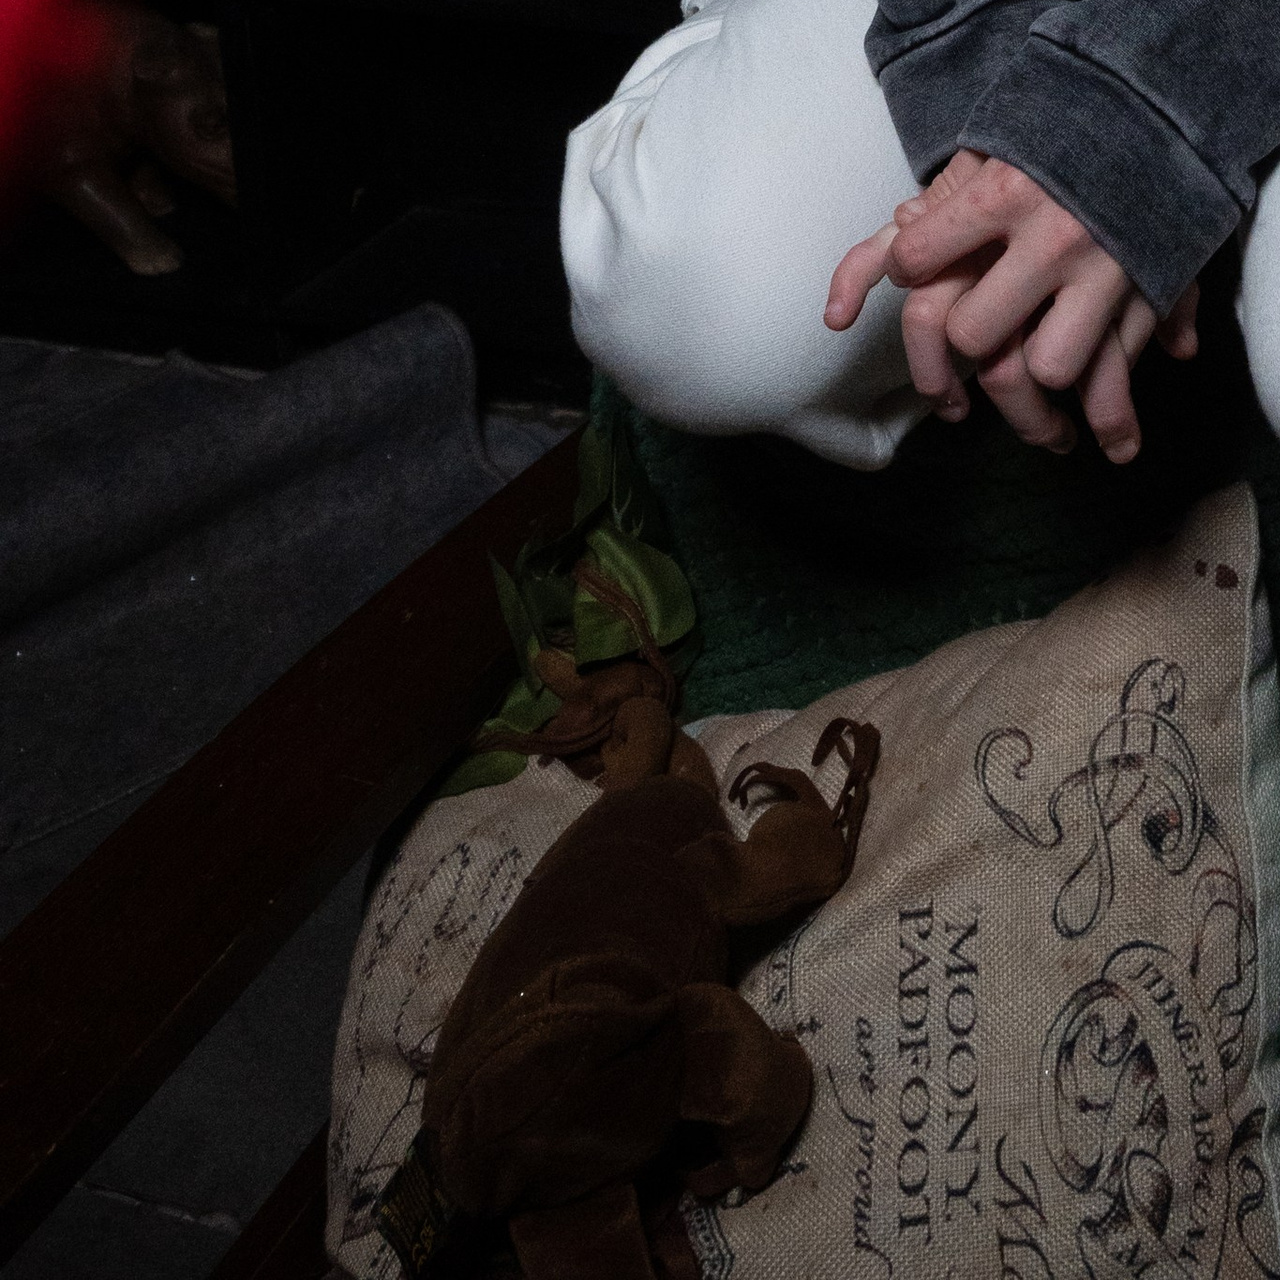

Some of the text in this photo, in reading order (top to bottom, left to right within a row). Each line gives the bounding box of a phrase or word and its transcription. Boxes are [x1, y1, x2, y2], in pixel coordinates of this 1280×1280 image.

[826, 1016, 894, 1277] are proud
[897, 899, 935, 1244] PADFOOT
